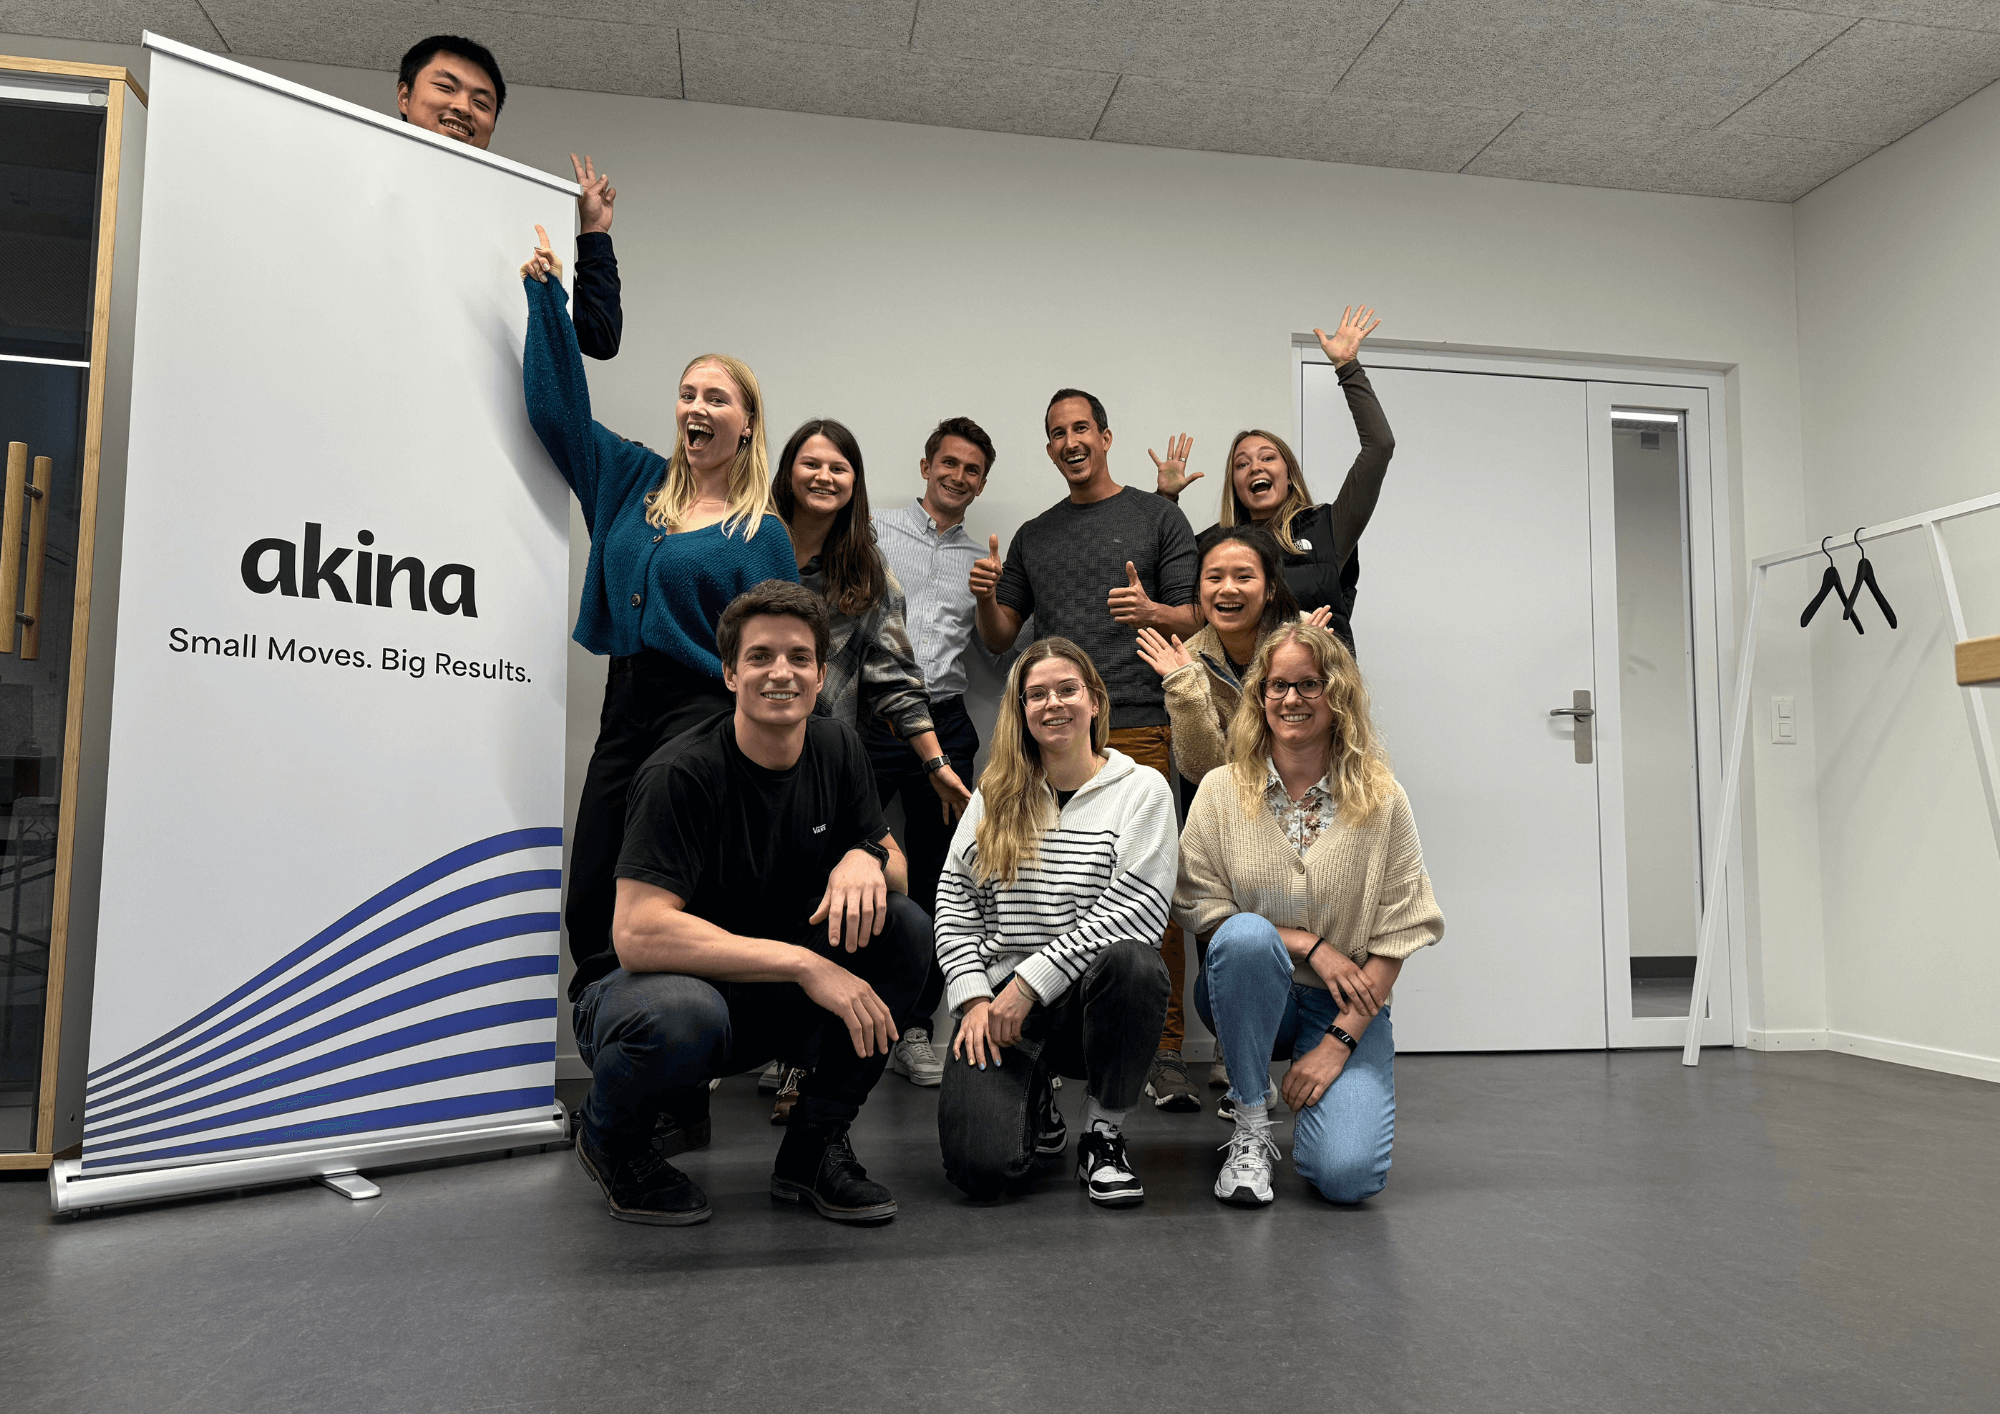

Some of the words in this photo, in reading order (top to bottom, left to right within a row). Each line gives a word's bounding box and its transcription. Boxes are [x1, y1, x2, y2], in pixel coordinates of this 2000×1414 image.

[240, 521, 479, 619] akina
[168, 627, 258, 660] Small
[268, 636, 373, 670] Moves.
[381, 647, 427, 679] Big
[435, 652, 533, 684] Results.
